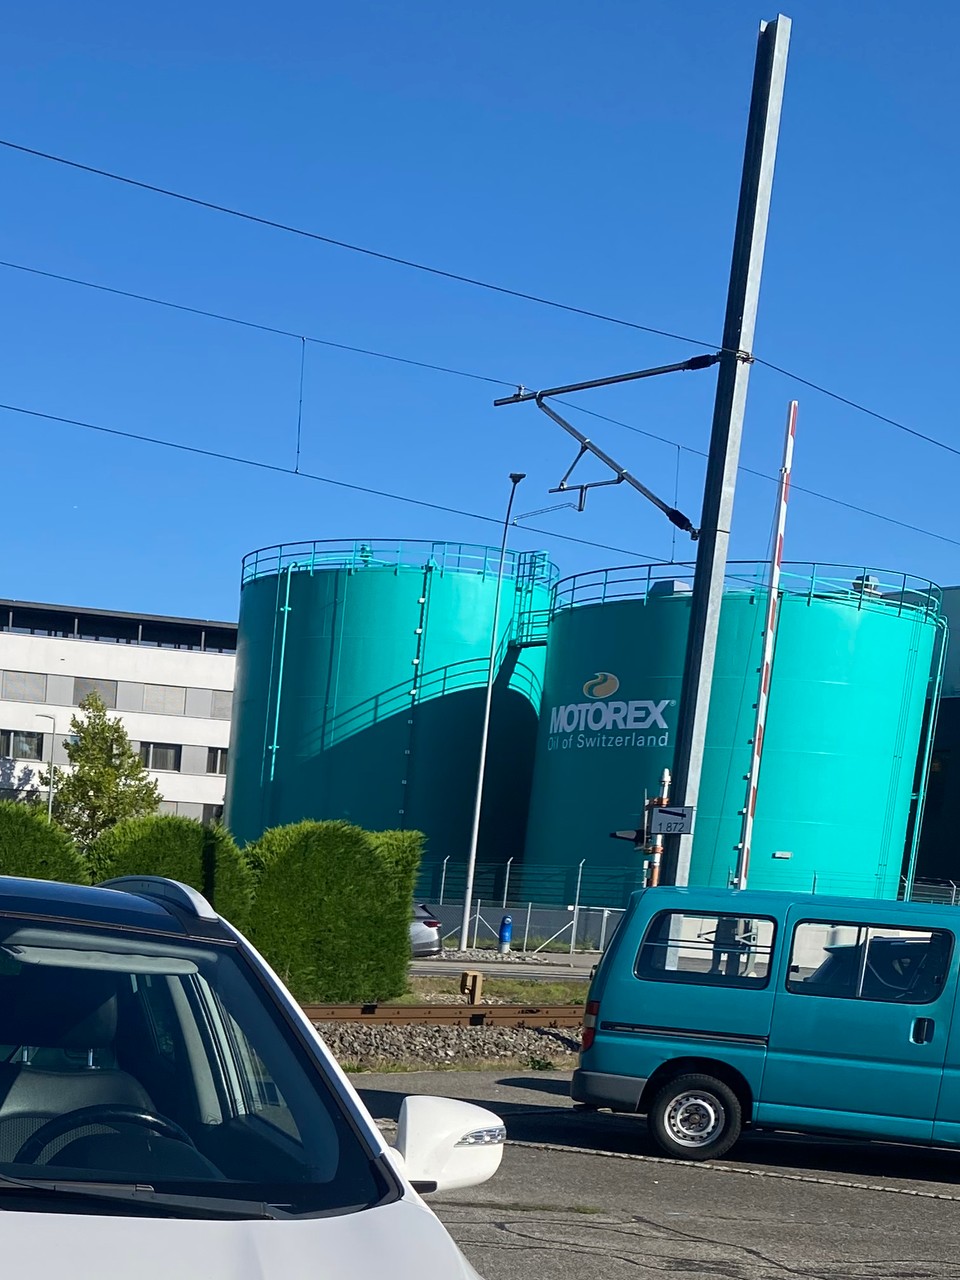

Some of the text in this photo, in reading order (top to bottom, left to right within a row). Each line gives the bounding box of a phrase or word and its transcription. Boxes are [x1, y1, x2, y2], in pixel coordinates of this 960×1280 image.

[549, 699, 671, 734] MOTOREX
[547, 731, 669, 751] Oil of Switzerland
[658, 822, 685, 832] 1.872
